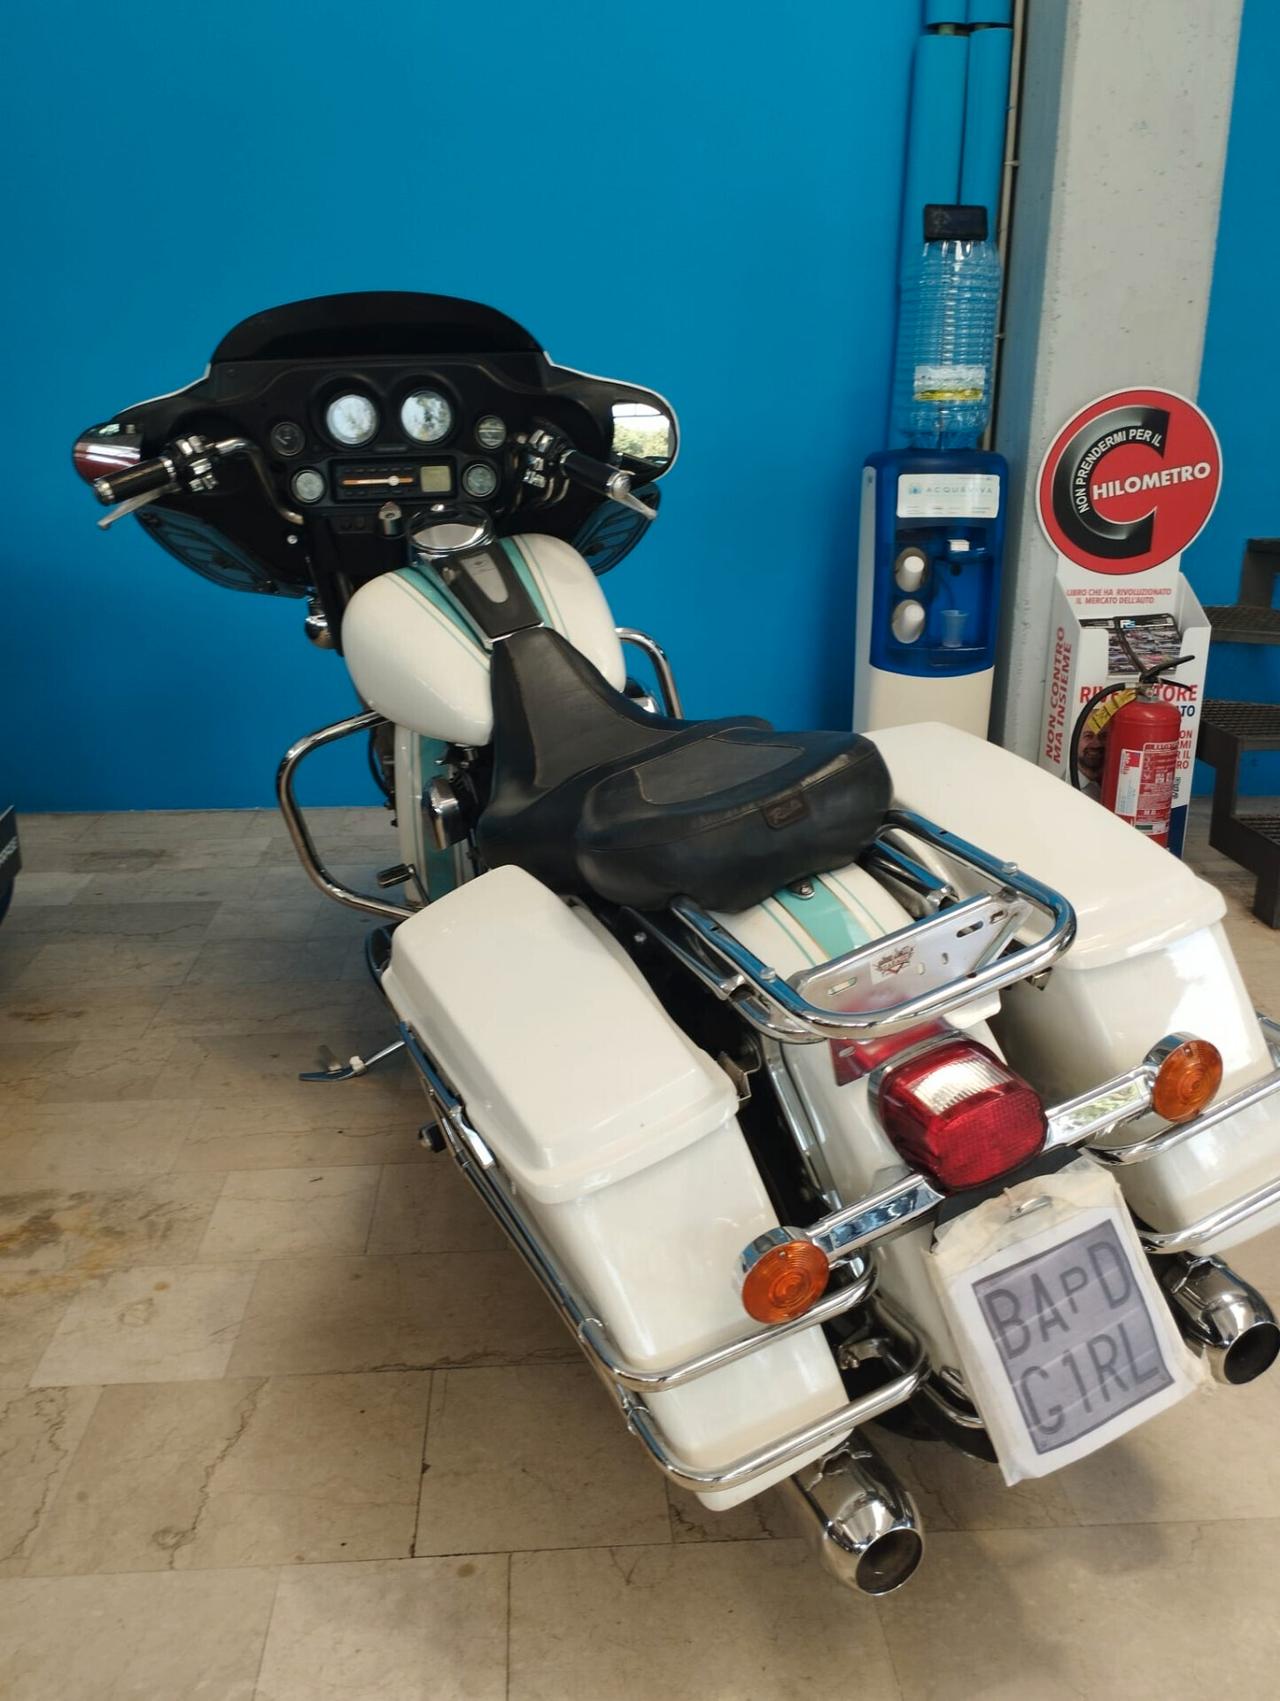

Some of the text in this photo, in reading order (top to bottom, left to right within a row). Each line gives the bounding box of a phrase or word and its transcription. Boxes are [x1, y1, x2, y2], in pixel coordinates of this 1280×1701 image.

[1076, 428, 1163, 514] NON PRENDERMI PER IL
[1092, 461, 1212, 500] HILOMETRO
[1066, 588, 1172, 596] LIBRO CHE HA RIVOLUZIONATO
[1045, 627, 1065, 759] NON CONTRO
[1053, 643, 1072, 764] MA INSIEME
[1183, 750, 1190, 759] IL
